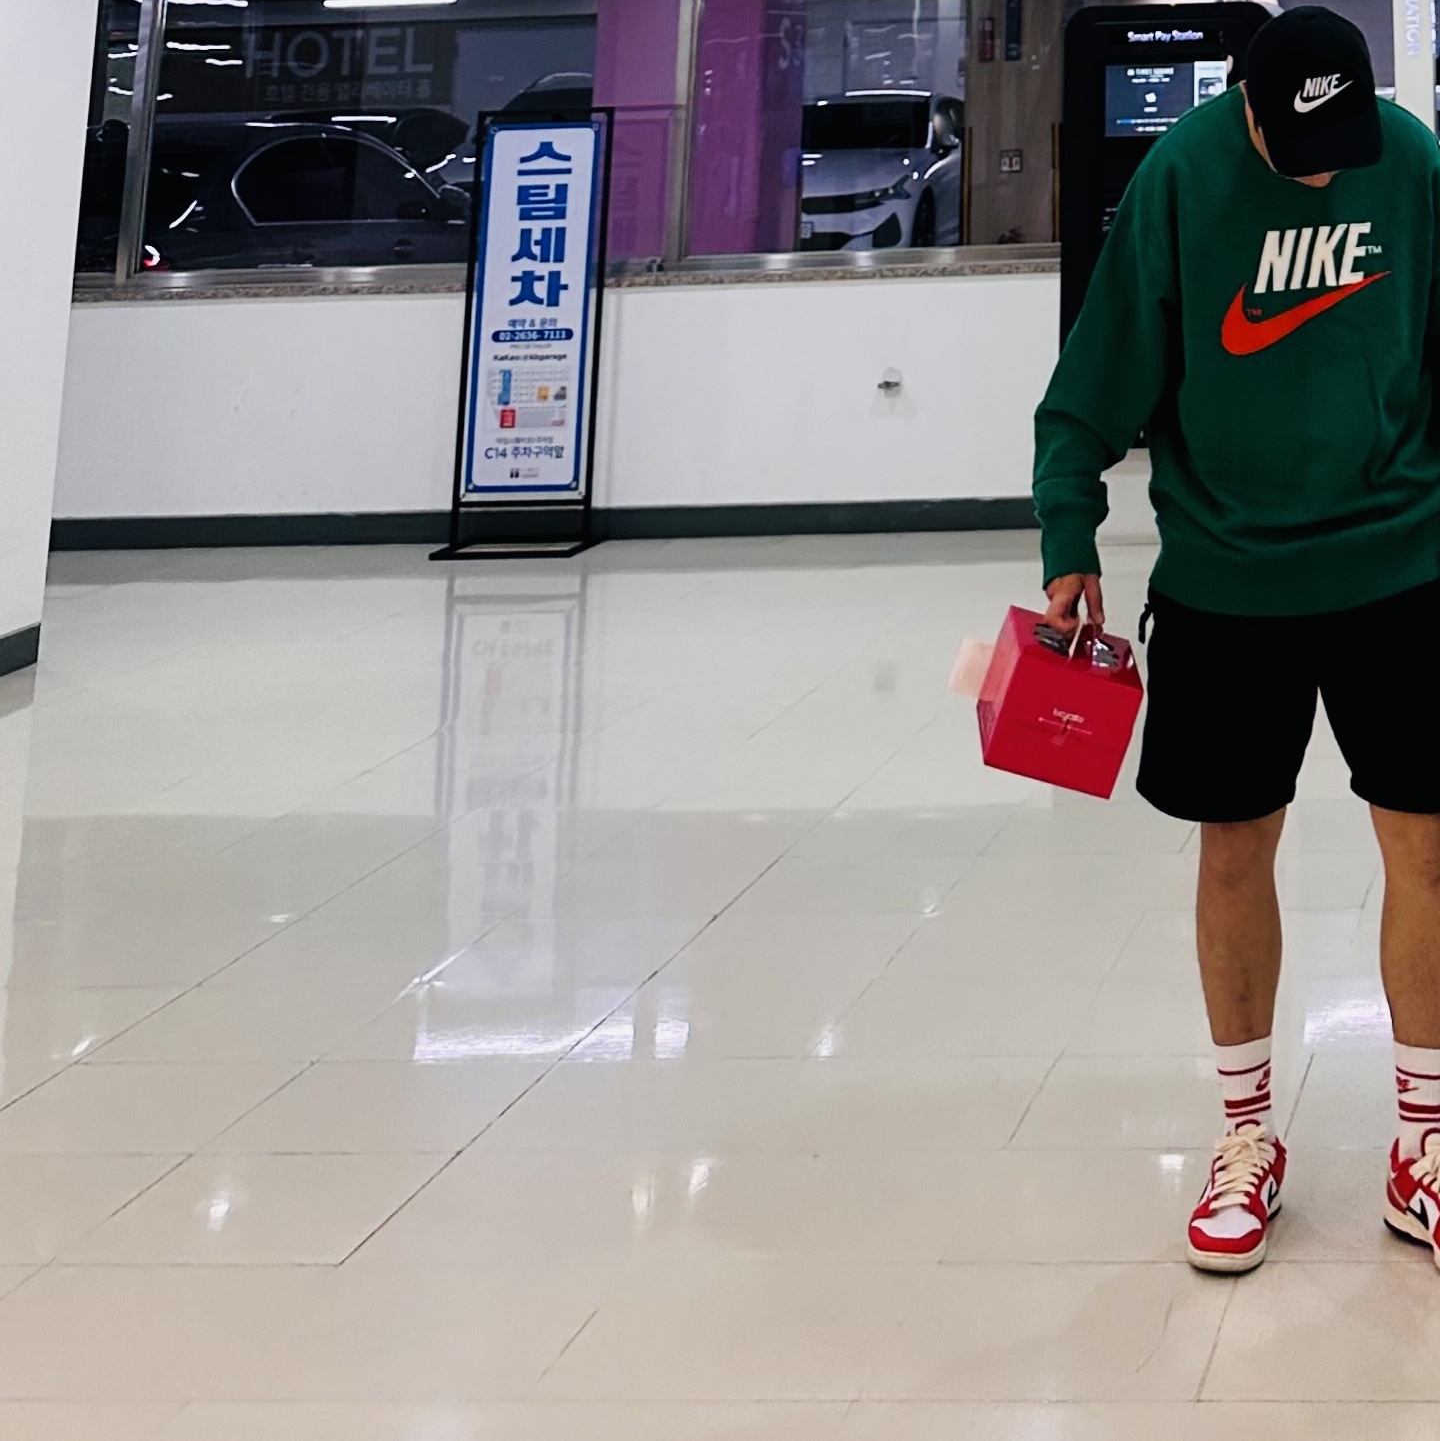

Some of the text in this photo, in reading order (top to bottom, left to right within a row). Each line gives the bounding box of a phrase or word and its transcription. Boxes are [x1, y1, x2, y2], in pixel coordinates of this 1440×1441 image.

[244, 27, 434, 79] HOTEL
[1127, 29, 1204, 43] Smart Pay Station
[1302, 73, 1342, 98] NIKE
[507, 140, 572, 308] 스팀세차
[1253, 221, 1372, 294] NIKE
